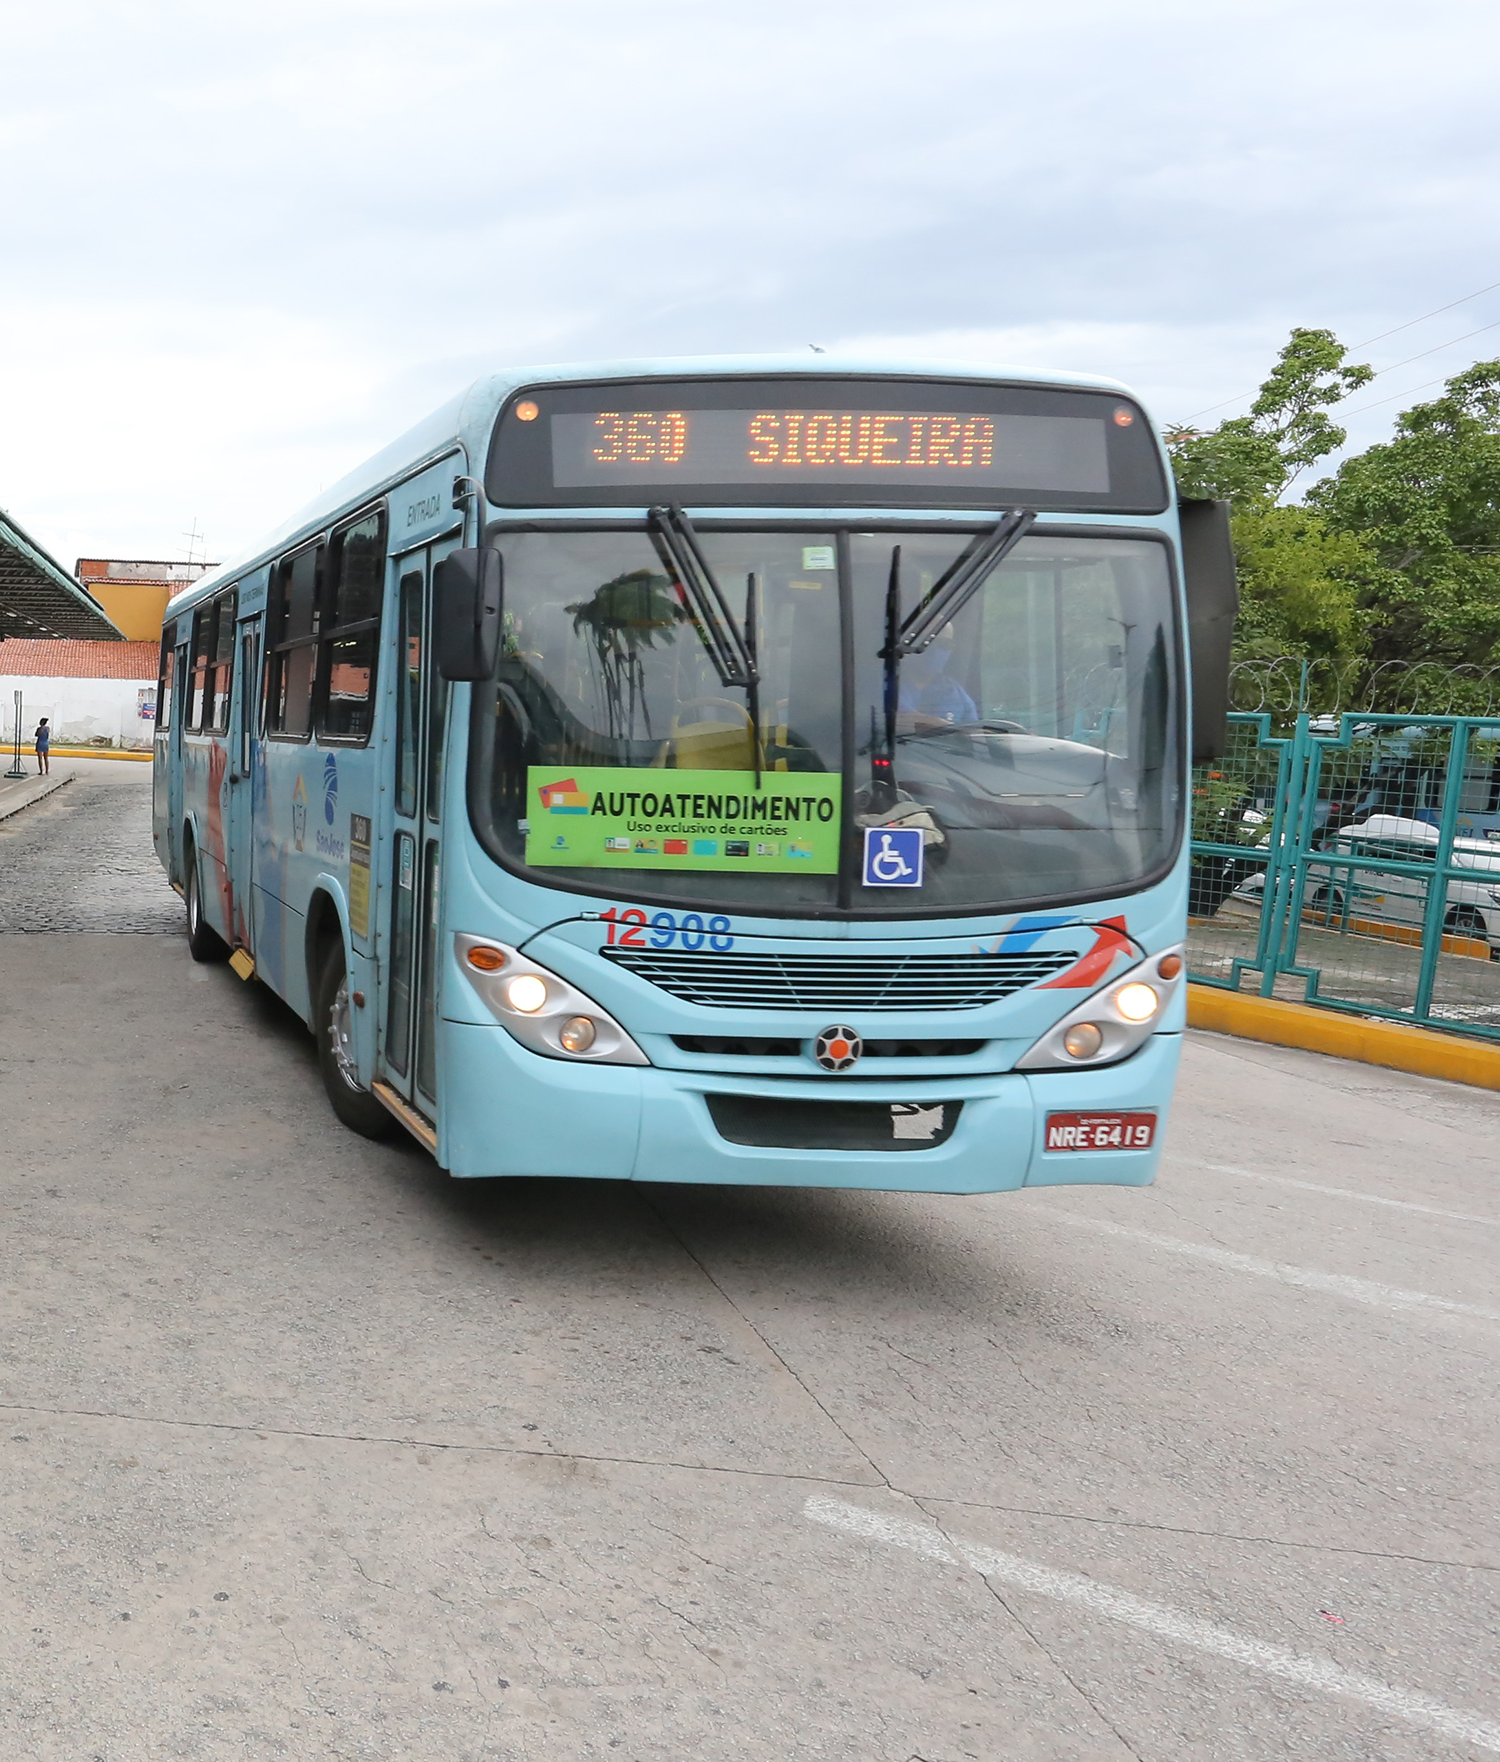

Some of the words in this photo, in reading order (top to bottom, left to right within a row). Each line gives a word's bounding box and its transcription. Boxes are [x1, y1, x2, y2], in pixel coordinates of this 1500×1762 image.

[593, 413, 687, 462] 360
[748, 415, 994, 466] SIQUEIRA
[407, 494, 440, 527] ENTRADA
[590, 792, 833, 821] AUTOATENDIMENTO
[626, 821, 652, 832] Uso
[656, 822, 717, 835] exclusivo
[720, 823, 736, 835] de
[740, 824, 788, 837] cartões
[600, 907, 734, 952] 12908
